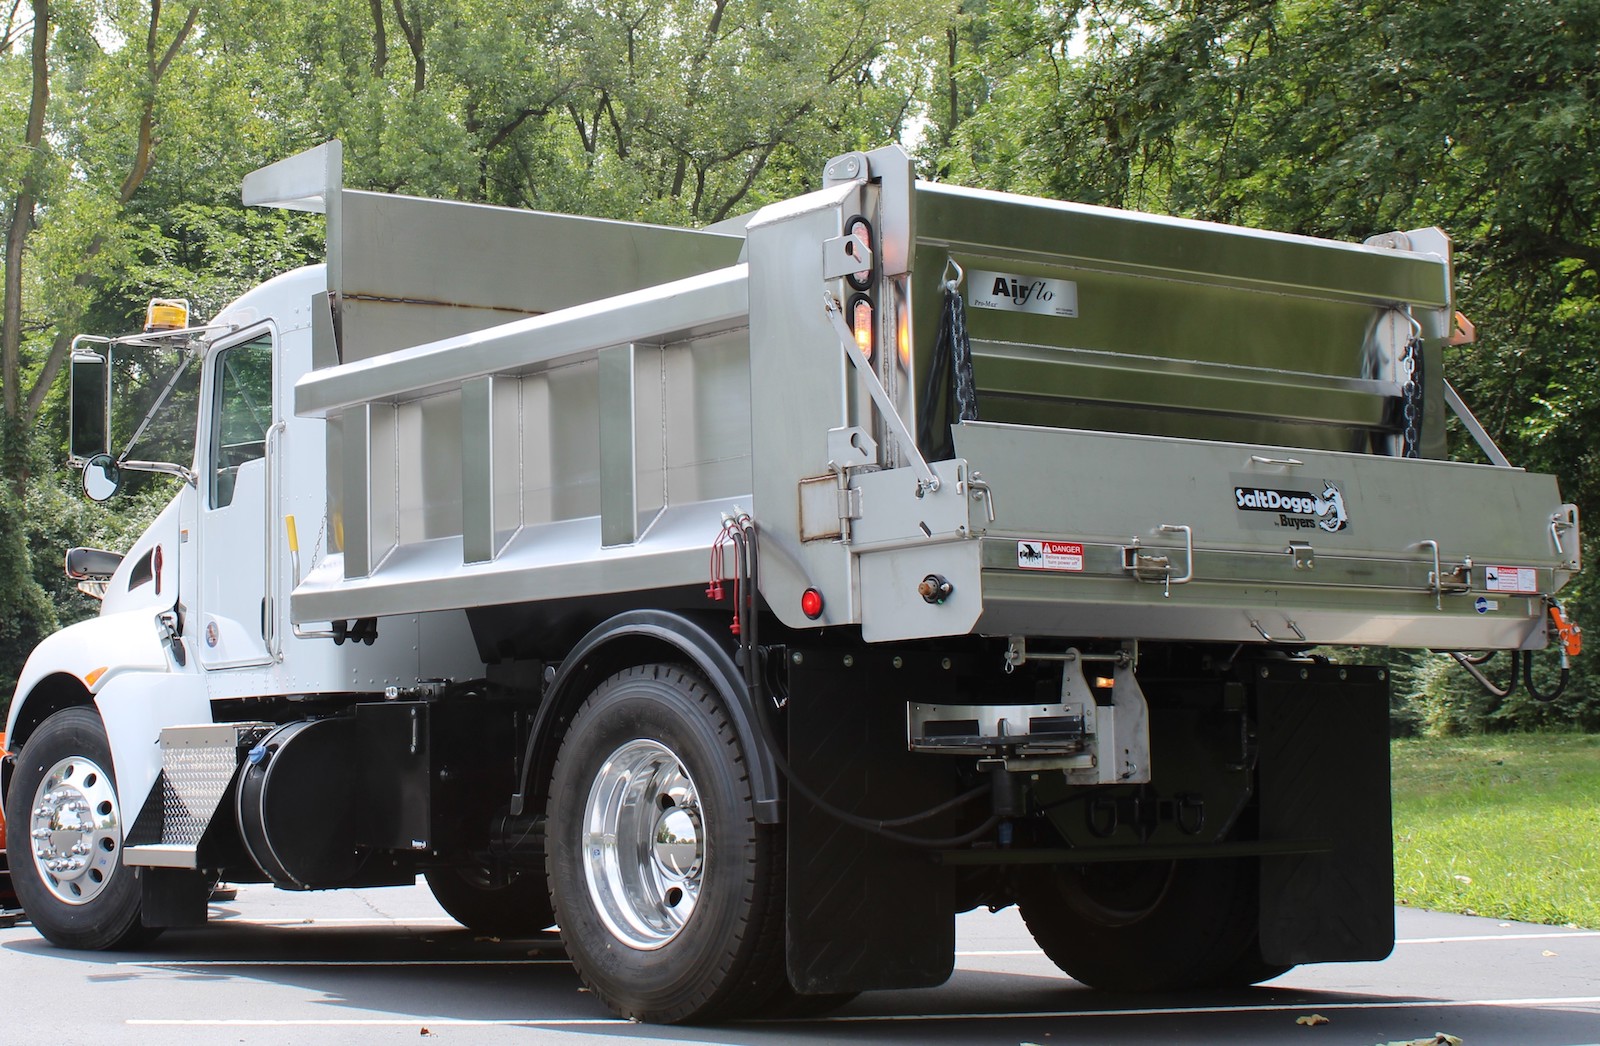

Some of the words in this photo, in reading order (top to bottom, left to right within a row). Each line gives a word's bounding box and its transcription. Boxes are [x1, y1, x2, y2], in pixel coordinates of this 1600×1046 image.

[992, 277, 1054, 306] Airflo
[1279, 513, 1316, 531] Buyers
[1052, 545, 1080, 553] DANGER
